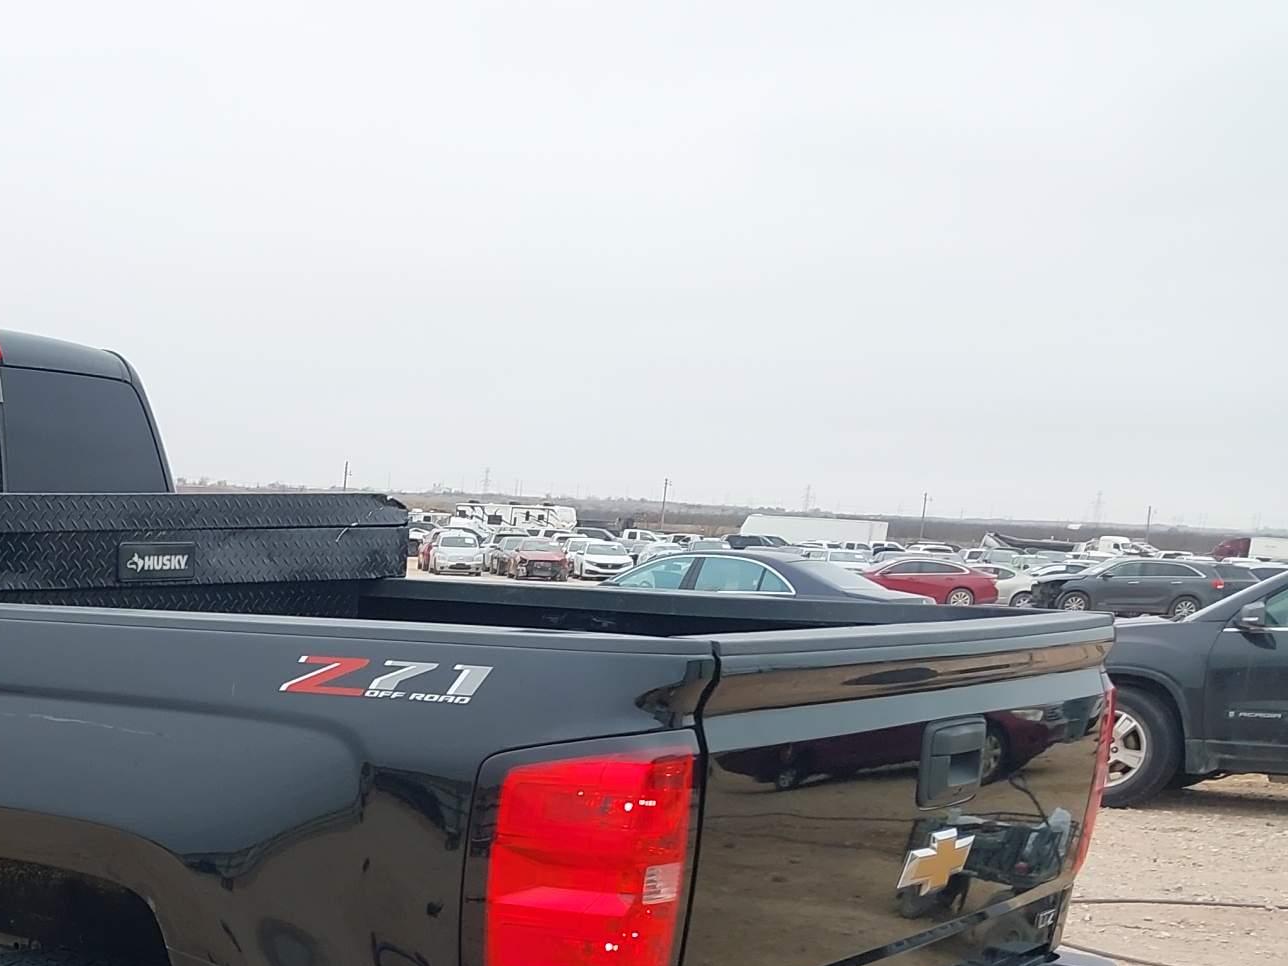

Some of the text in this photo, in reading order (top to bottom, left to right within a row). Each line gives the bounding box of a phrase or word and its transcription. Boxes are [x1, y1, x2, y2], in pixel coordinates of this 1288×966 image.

[143, 554, 188, 570] HUSKY
[279, 655, 495, 697] Z71
[364, 688, 472, 705] OFF ROAD
